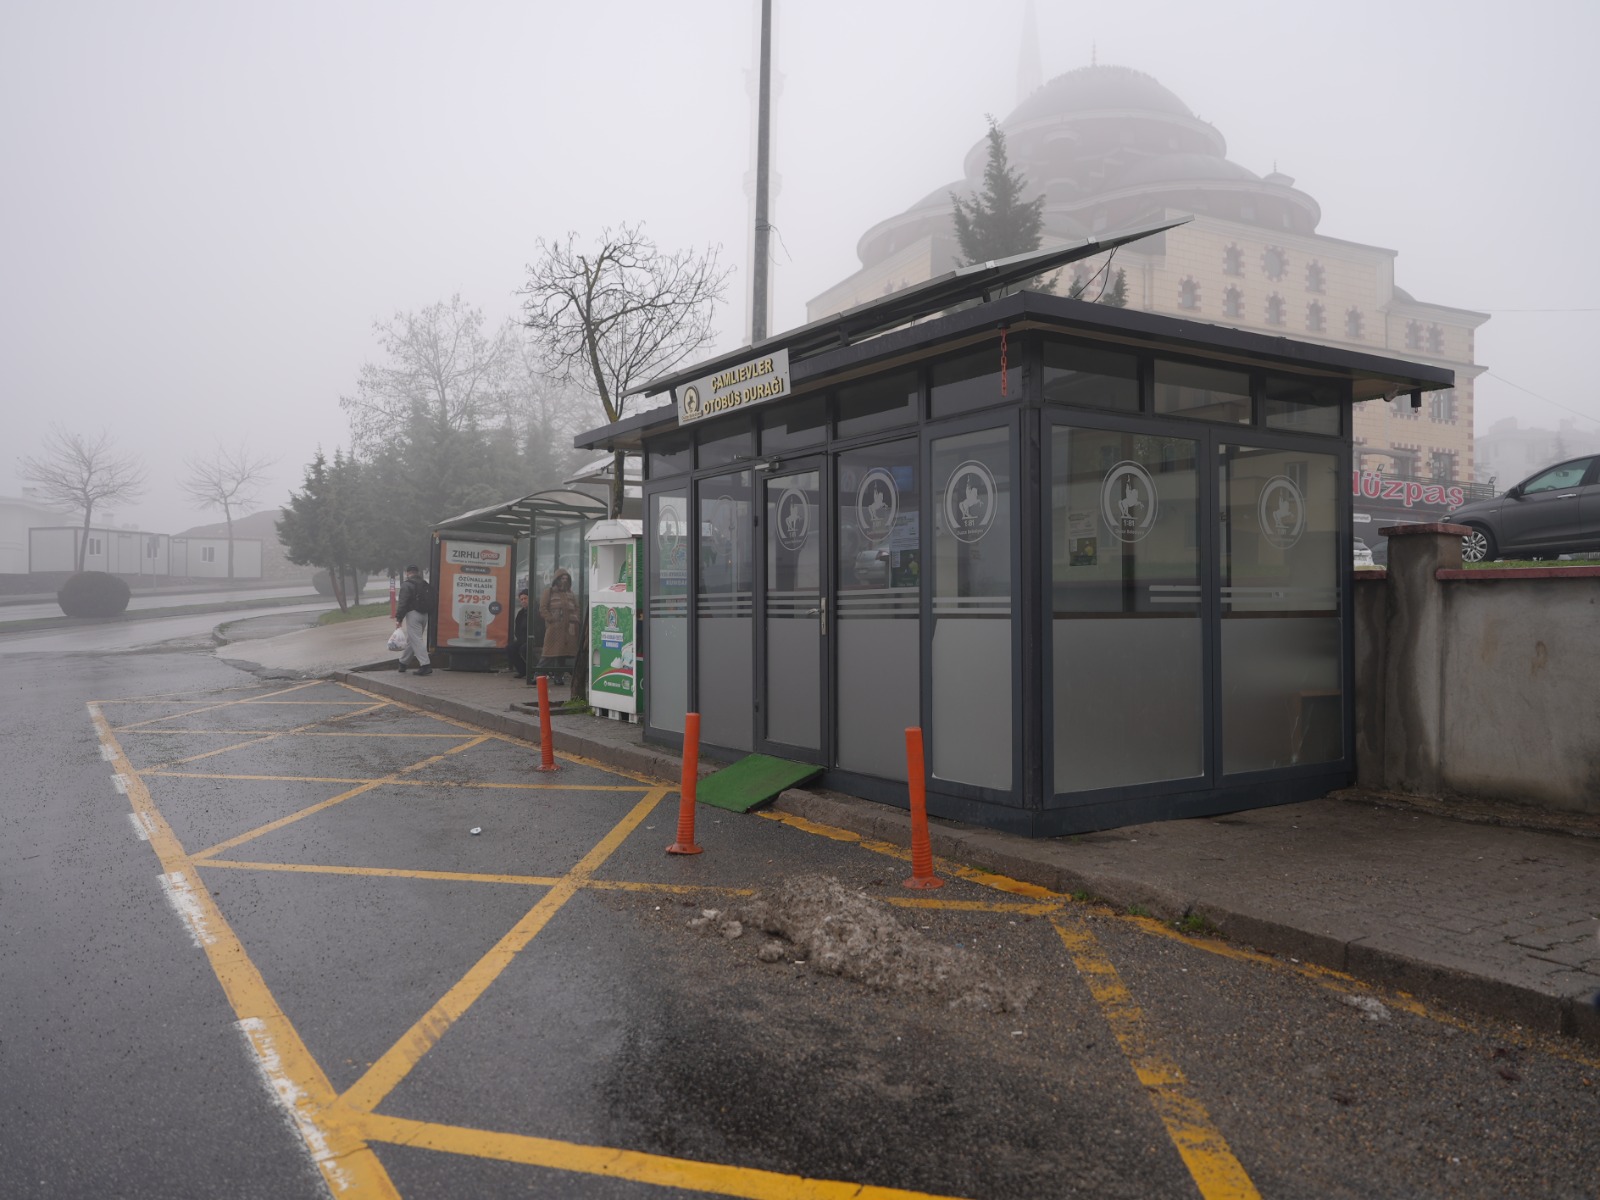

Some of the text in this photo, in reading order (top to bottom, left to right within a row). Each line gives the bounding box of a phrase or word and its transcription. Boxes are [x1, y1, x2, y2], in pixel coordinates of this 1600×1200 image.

[711, 358, 774, 393] ÇAMLIEVLER
[703, 376, 784, 415] OTOBÜS DURAĞI
[452, 550, 480, 559] ZIRHLI
